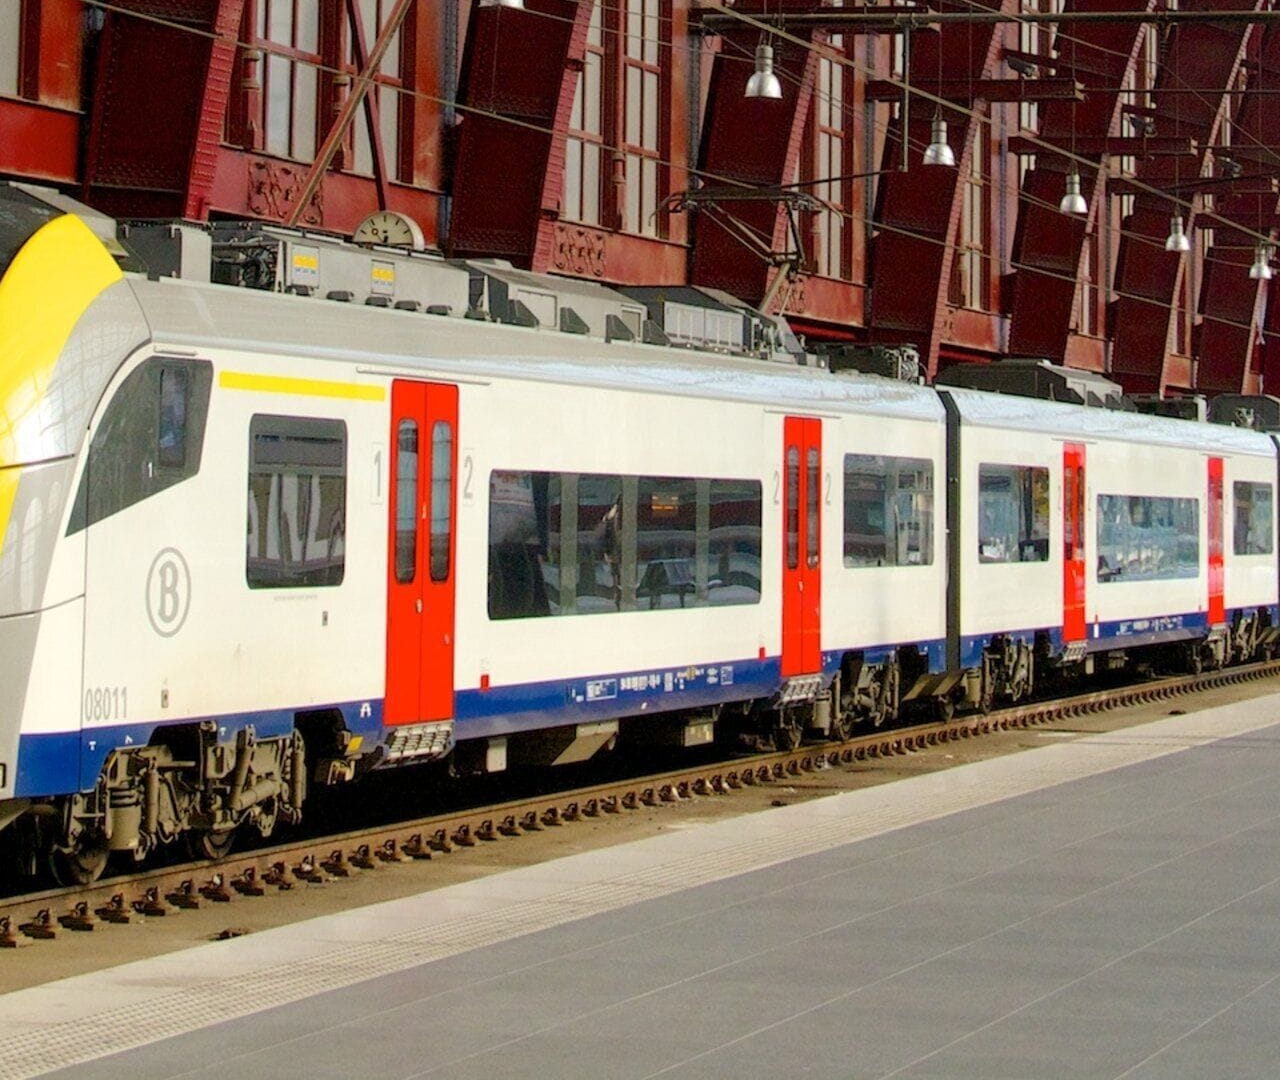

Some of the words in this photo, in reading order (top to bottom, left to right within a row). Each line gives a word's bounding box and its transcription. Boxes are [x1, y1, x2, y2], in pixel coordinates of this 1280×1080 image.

[374, 450, 382, 497] 1
[463, 454, 474, 499] 2
[84, 686, 127, 721] 08011
